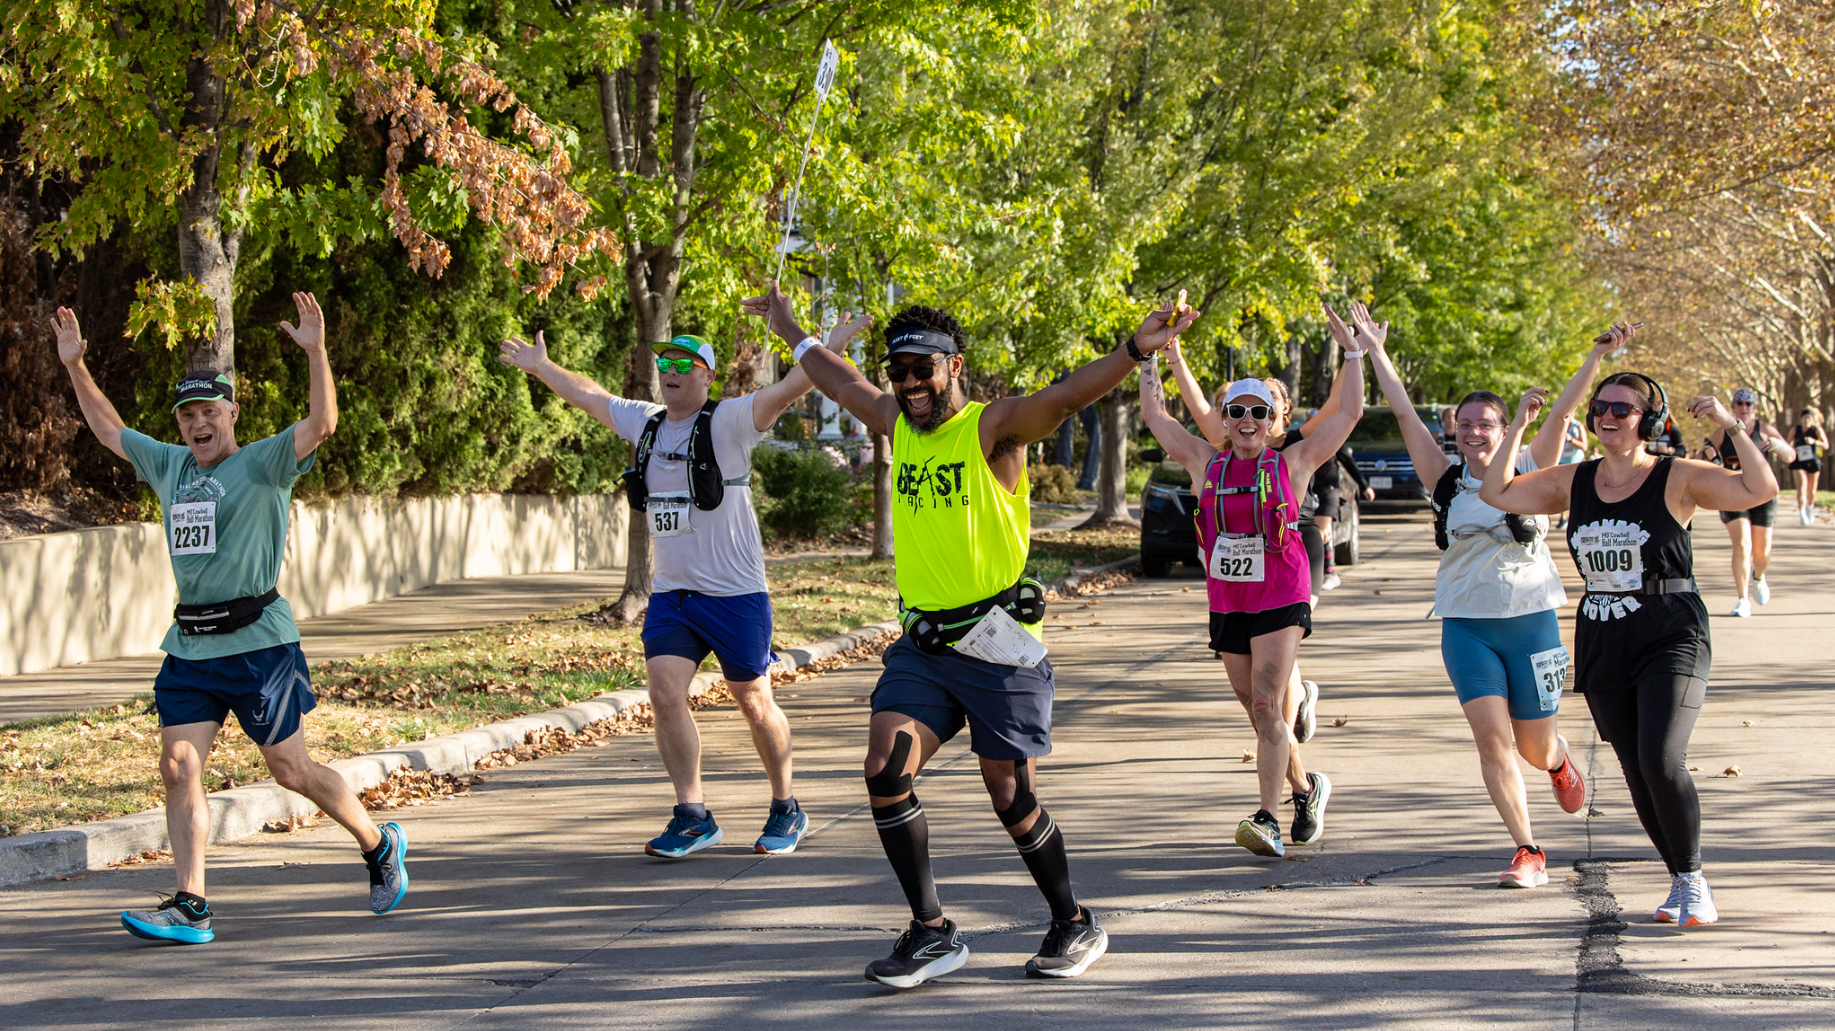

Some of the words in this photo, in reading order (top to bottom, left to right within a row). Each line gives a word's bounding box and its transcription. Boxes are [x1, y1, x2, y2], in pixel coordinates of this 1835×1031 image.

[180, 382, 213, 393] MARATHON
[897, 457, 965, 497] BEAST
[655, 511, 679, 531] 537
[175, 525, 210, 549] 2237
[1602, 538, 1612, 547] Half
[1612, 538, 1637, 546] Marathon
[1220, 557, 1253, 576] 522
[1585, 549, 1633, 572] 1009
